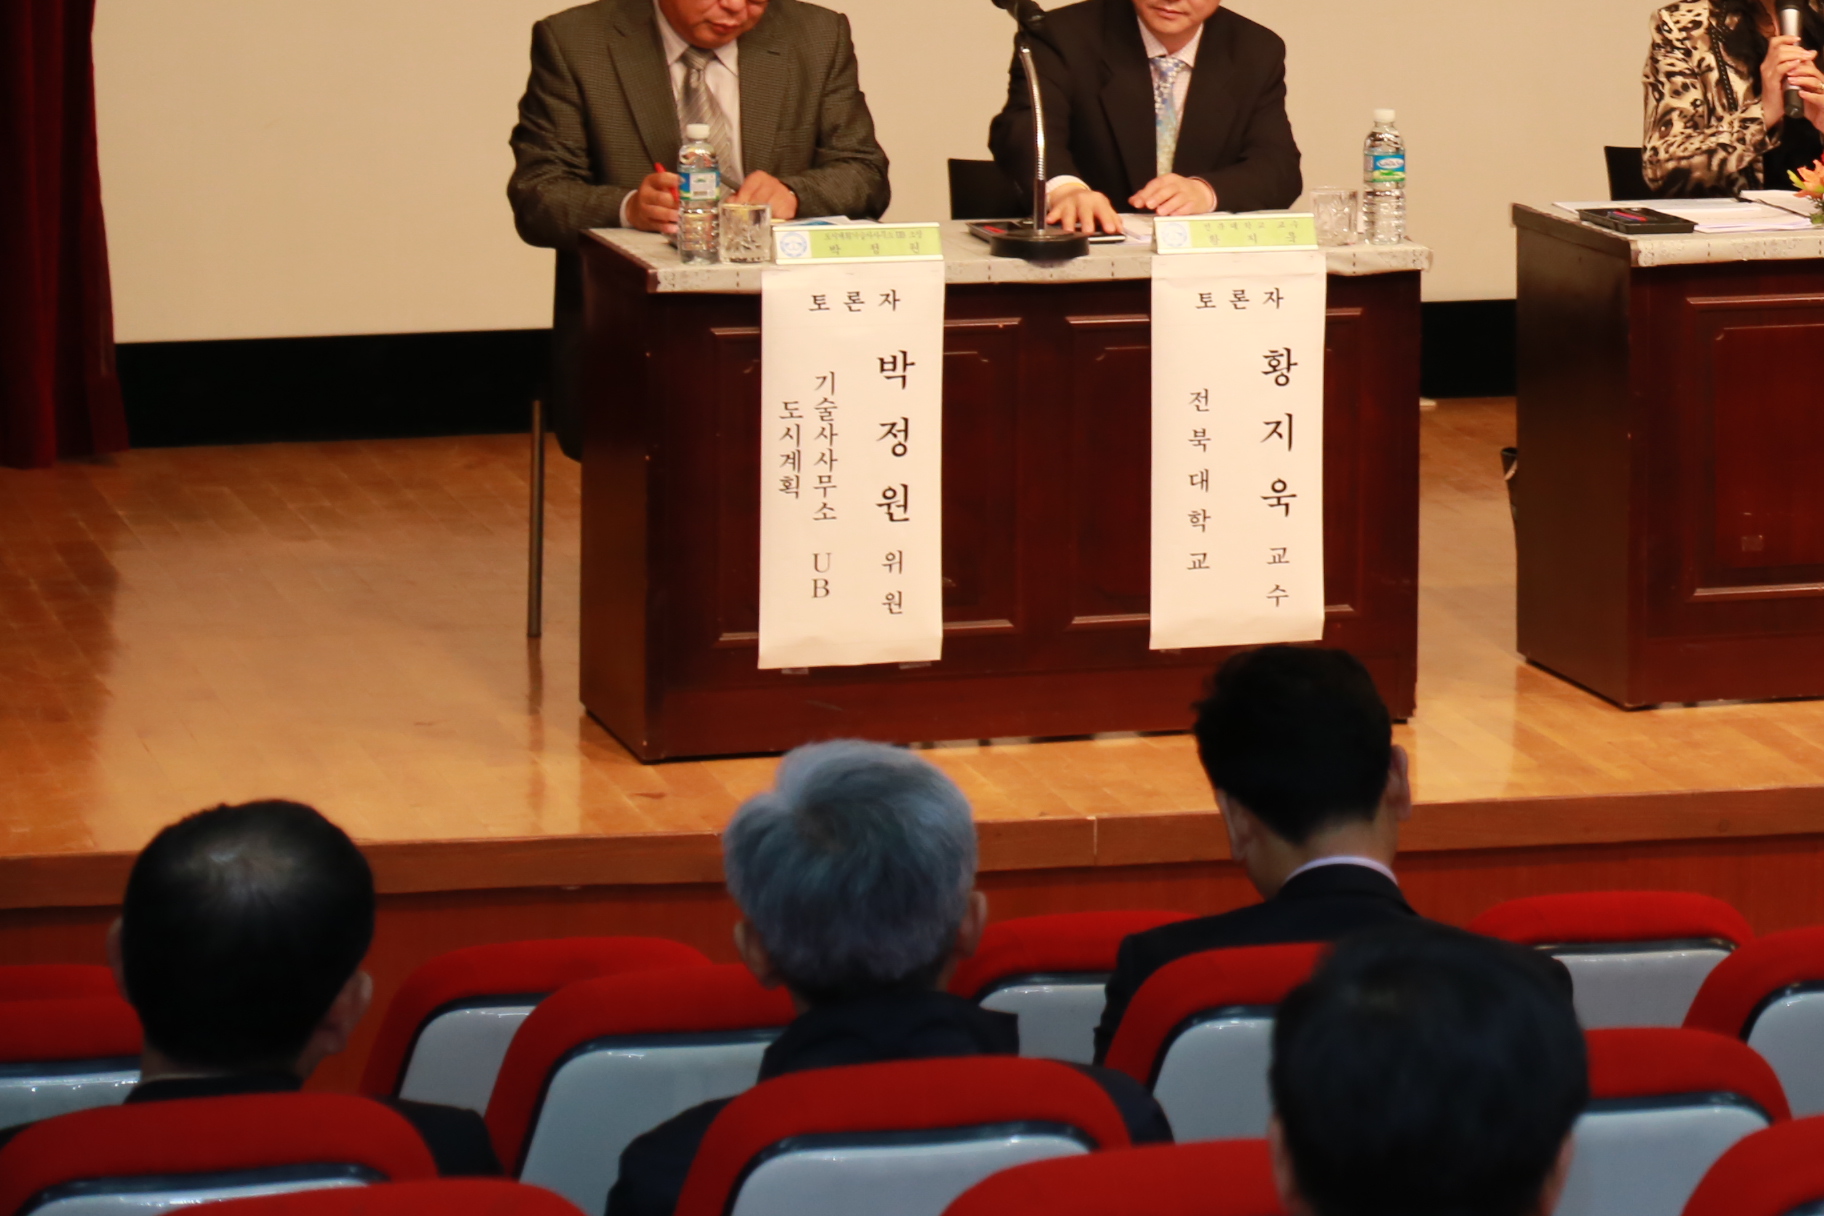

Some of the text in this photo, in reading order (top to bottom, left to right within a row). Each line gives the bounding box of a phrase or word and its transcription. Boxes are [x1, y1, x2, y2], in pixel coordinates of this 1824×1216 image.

[778, 400, 804, 499] 도시계획
[813, 371, 839, 521] 기술사사무소
[876, 350, 916, 615] 박정원 위원
[1187, 388, 1211, 571] 전북대학교
[1261, 347, 1298, 608] 황지욱 교수
